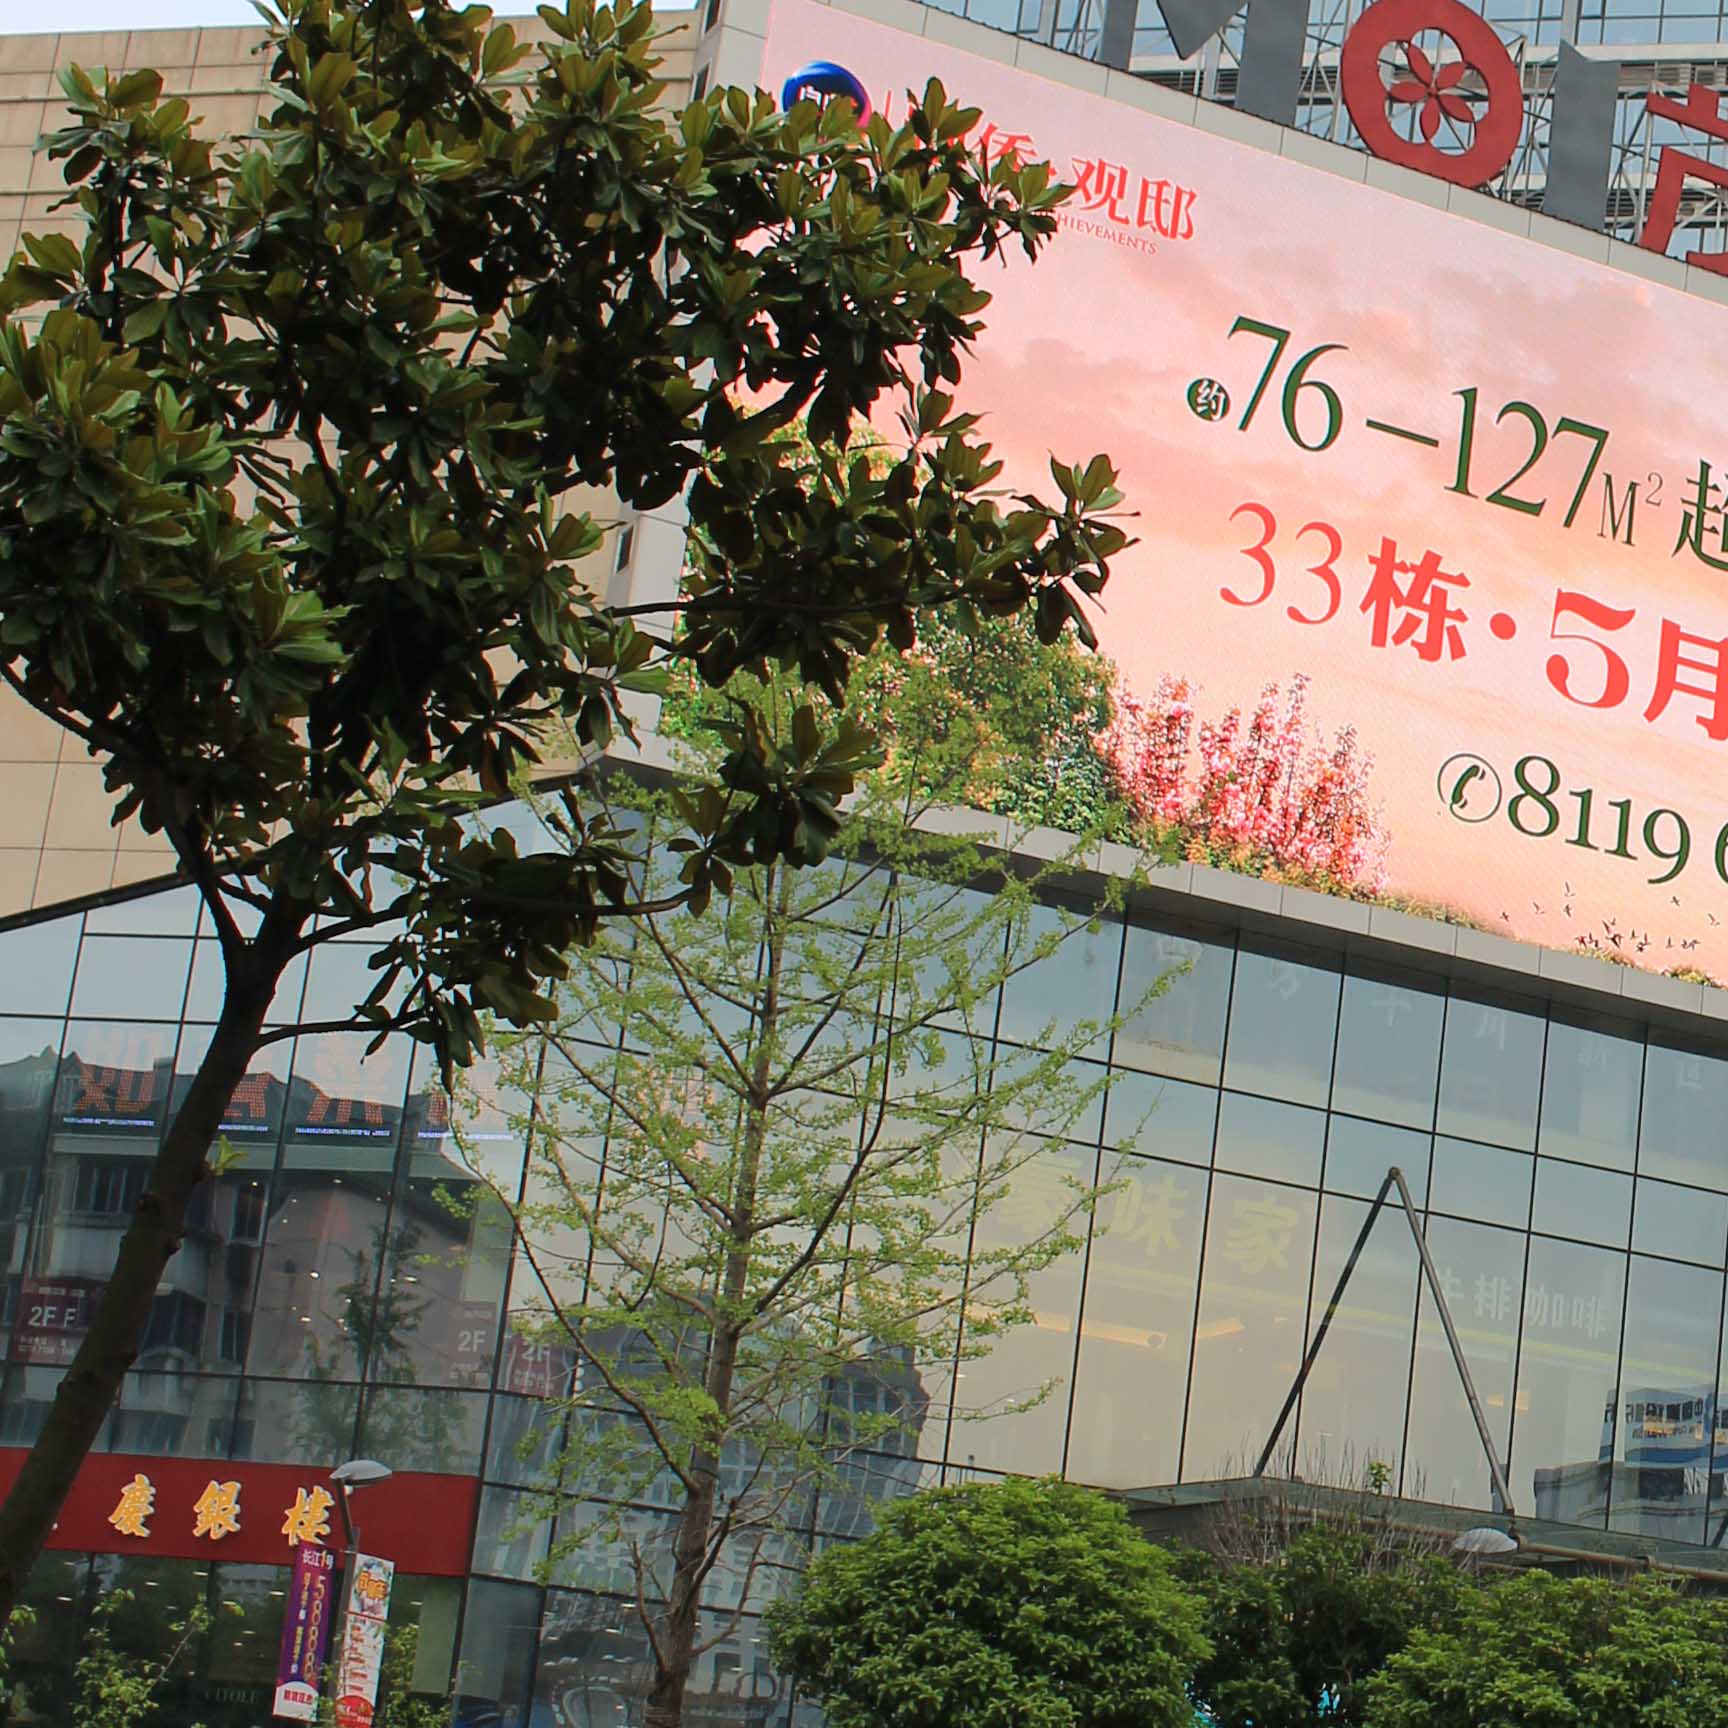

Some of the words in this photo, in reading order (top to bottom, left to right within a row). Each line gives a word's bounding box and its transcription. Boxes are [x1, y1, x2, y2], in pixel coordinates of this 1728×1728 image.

[1054, 212, 1160, 257] HIEVEMENTS
[1507, 756, 1692, 884] 8119
[457, 1330, 487, 1353] 2F
[52, 1473, 336, 1547] 慶銀樓
